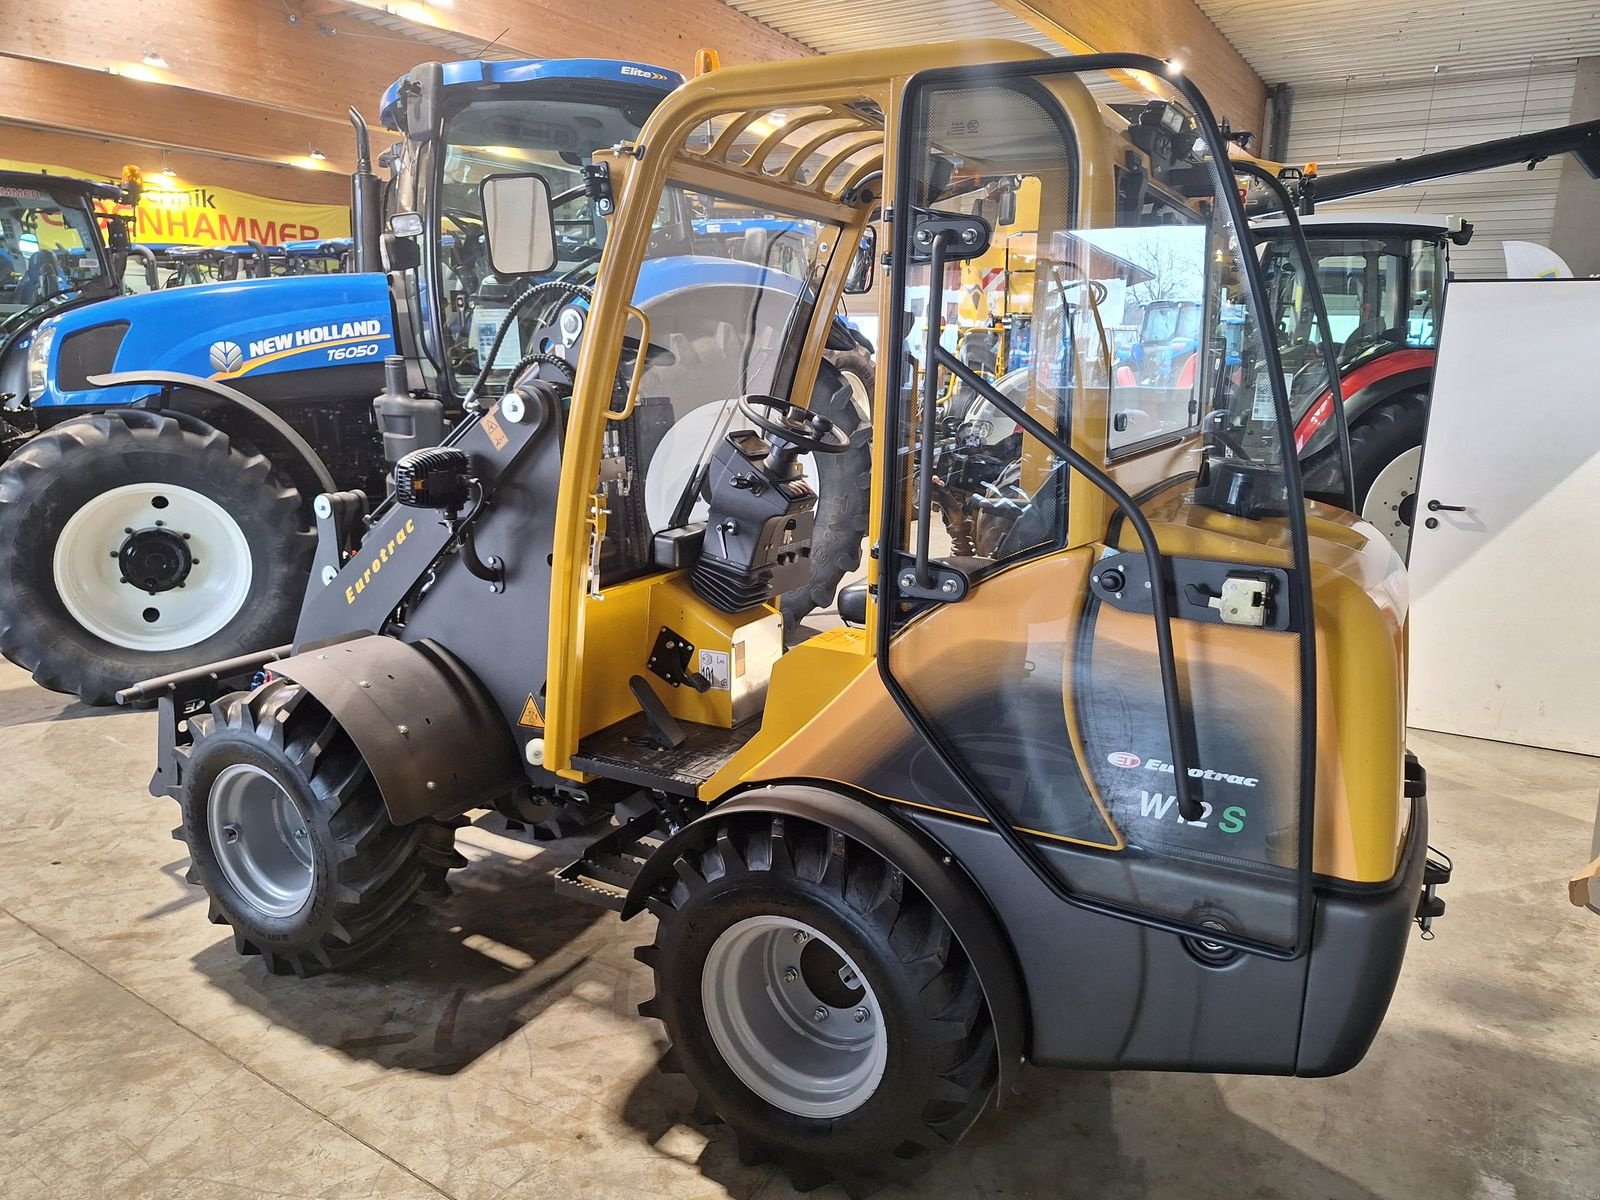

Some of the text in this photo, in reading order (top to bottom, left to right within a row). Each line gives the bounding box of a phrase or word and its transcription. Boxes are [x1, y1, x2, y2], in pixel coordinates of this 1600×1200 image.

[620, 65, 652, 79] Elite
[249, 319, 381, 358] NEW HOLLAND
[327, 343, 379, 362] T6050
[345, 518, 415, 605] Eurotrac
[1144, 758, 1259, 788] Euotrac
[1218, 805, 1247, 834] S
